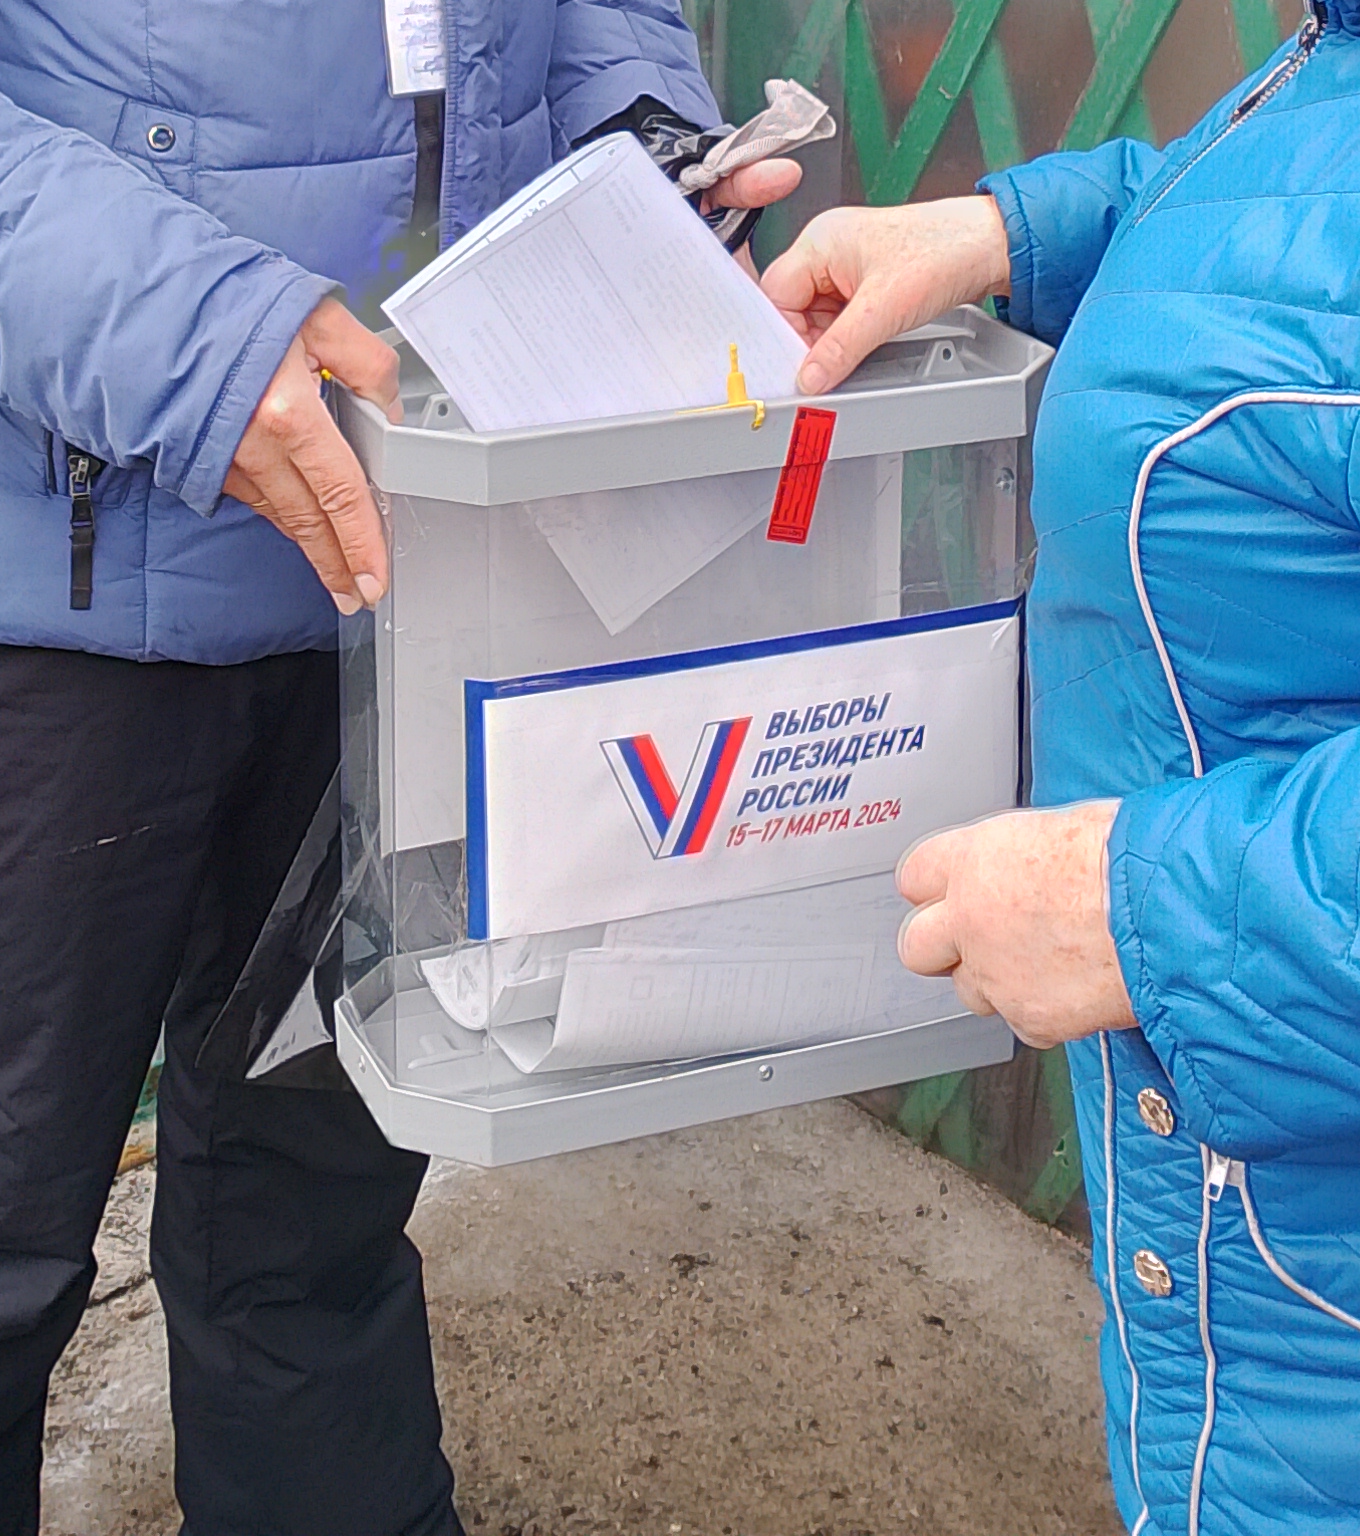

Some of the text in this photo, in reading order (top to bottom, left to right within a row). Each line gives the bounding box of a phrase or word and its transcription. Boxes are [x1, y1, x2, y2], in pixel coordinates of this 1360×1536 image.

[765, 692, 892, 740] ВЫБОРЫ
[751, 724, 925, 779] ПРЕЗИДЕНТА
[737, 773, 853, 817] РОССИИ
[783, 807, 852, 839] МАРТА
[853, 797, 902, 828] 2024
